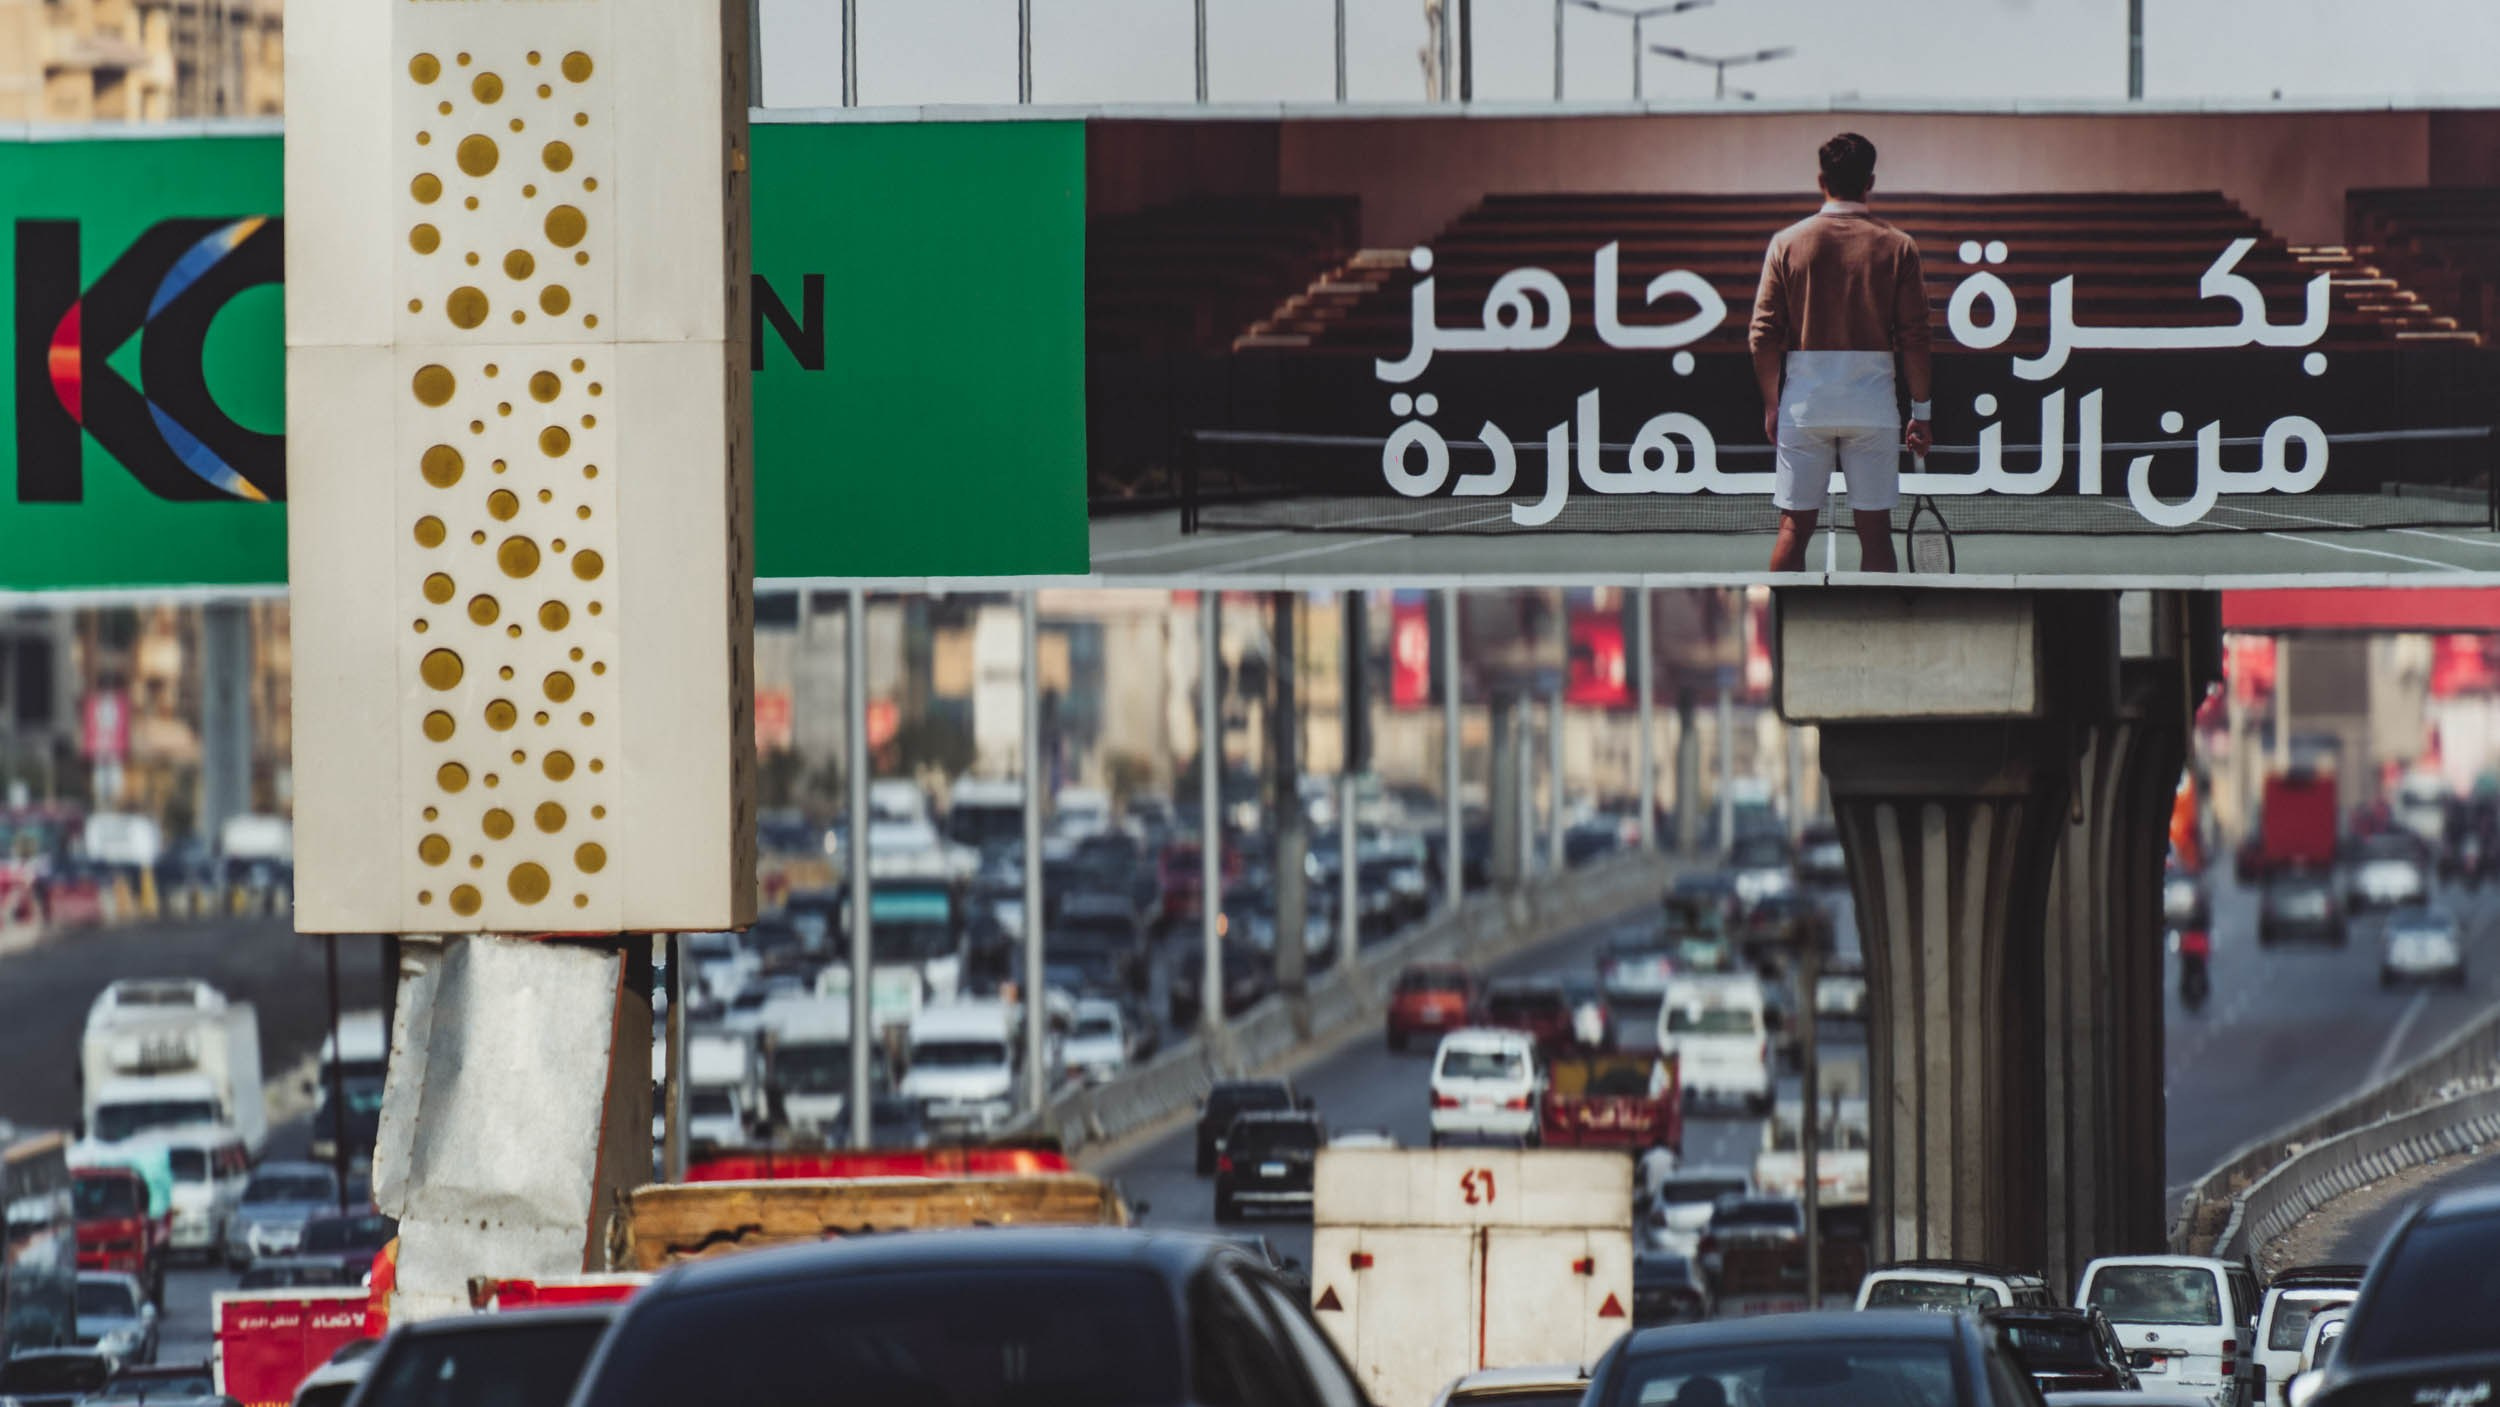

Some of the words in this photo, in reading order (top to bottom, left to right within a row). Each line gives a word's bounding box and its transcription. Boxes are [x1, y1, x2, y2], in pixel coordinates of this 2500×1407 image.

[750, 272, 825, 372] N
[1375, 240, 1728, 383] جاهز
[1947, 237, 2331, 382] بكرة
[2127, 411, 2330, 527] من
